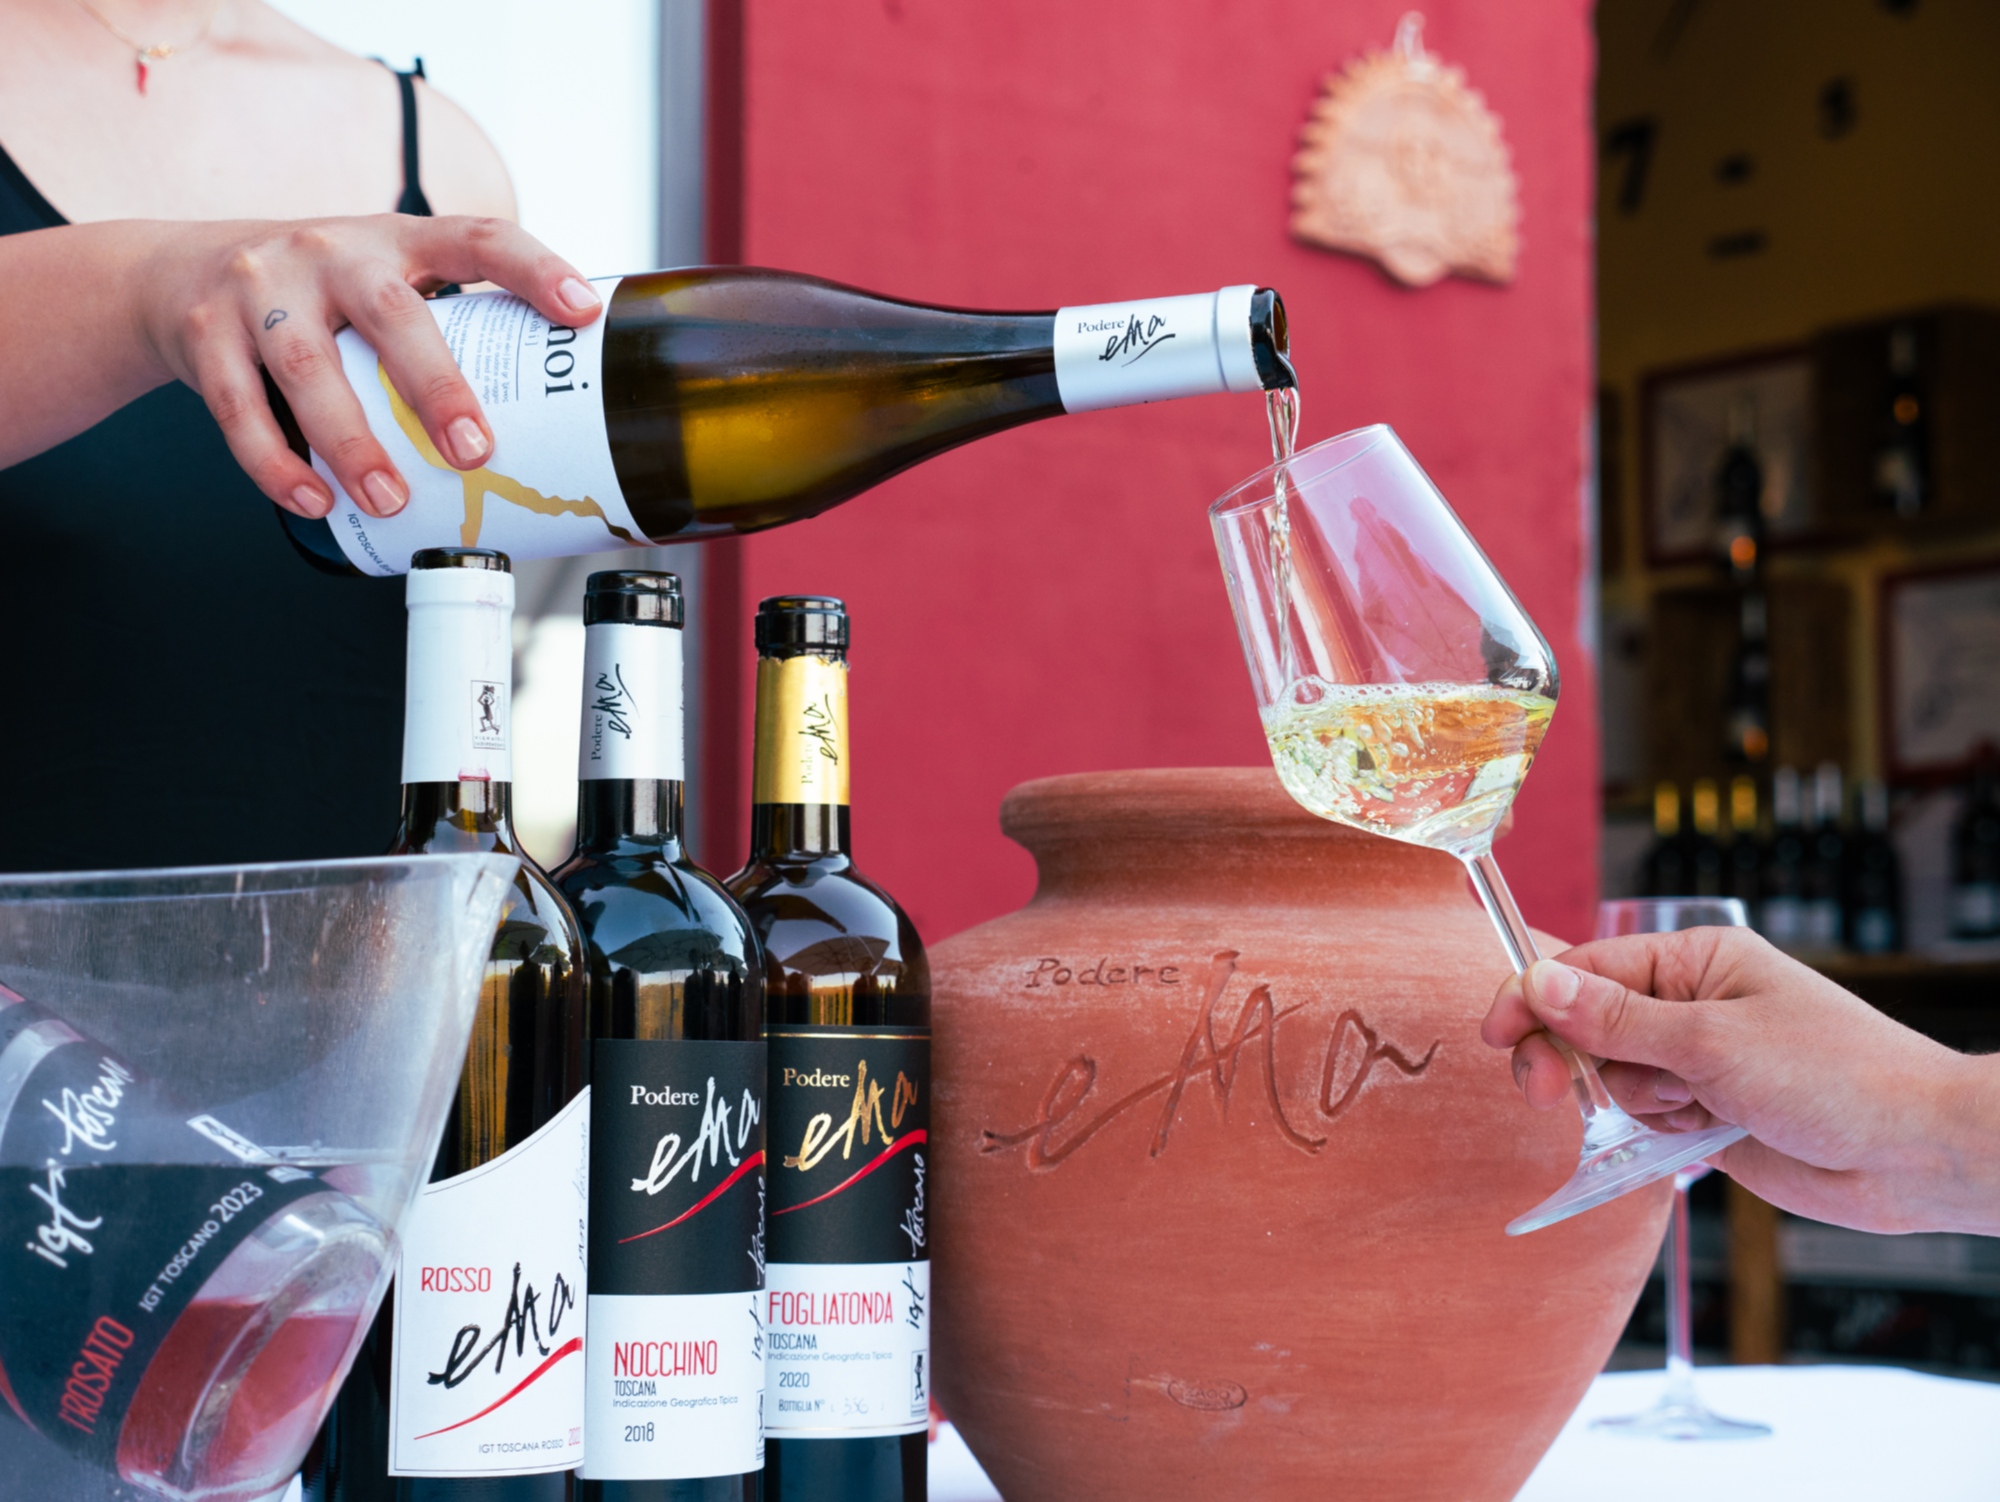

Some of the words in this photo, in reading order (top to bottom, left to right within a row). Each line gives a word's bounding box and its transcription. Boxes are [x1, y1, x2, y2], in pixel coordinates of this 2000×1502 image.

[1078, 318, 1125, 334] Podere
[544, 323, 589, 398] noi
[347, 513, 362, 529] IGT
[591, 714, 603, 761] Podere
[1024, 956, 1182, 989] Podere
[782, 1067, 850, 1089] Podere
[630, 1084, 700, 1107] Podere
[138, 1283, 166, 1313] IGT
[158, 1218, 221, 1286] TOSCANO
[210, 1181, 263, 1223] 2023
[421, 1266, 492, 1293] ROSSO
[768, 1290, 894, 1326] FOGLIATONDA
[767, 1332, 818, 1351] TOSCANA
[613, 1340, 718, 1378] NOCCHINO
[767, 1351, 820, 1362] Indicazione
[821, 1351, 871, 1363] Geografica
[872, 1351, 893, 1361] Tipica
[614, 1380, 657, 1397] TOSCANA
[778, 1371, 811, 1389] 2020
[612, 1398, 668, 1408] Indicazione
[669, 1396, 718, 1409] Geografica
[719, 1395, 739, 1406] Tipica
[624, 1421, 656, 1443] 2018
[478, 1443, 495, 1454] IGT
[496, 1440, 541, 1454] TOSCANA
[541, 1438, 565, 1451] ROSSO
